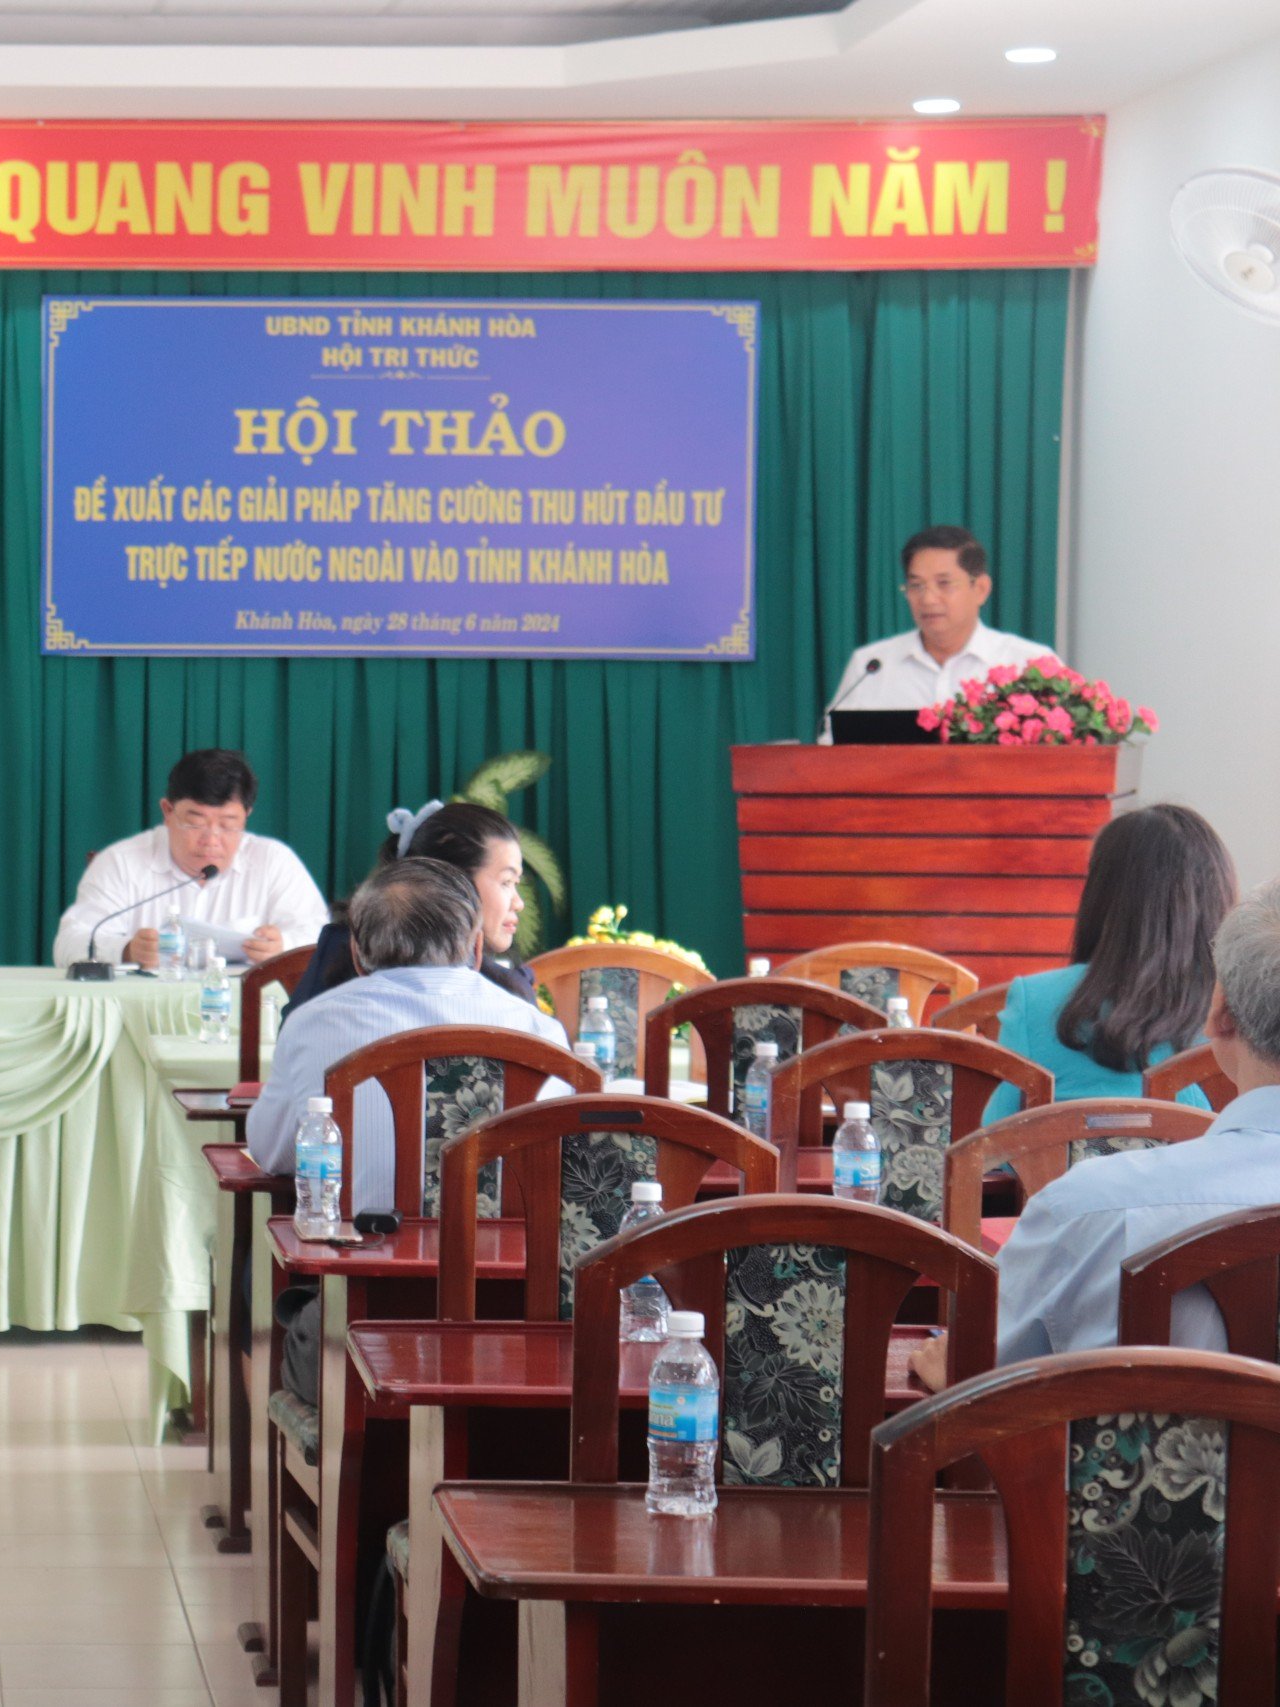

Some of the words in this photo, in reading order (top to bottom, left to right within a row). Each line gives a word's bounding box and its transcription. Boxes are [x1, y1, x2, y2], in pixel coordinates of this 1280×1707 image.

[297, 162, 496, 238] VINH
[524, 149, 782, 240] MUÔN
[809, 146, 1010, 238] NĂM
[1043, 160, 1067, 233] !
[265, 315, 332, 337] UBND
[337, 309, 394, 337] TỈNH
[400, 312, 482, 338] KHÁNH
[488, 313, 538, 338] HÒA
[322, 342, 363, 371] HỘI
[416, 343, 480, 369] THỨC
[234, 396, 359, 466] HỘI
[379, 393, 568, 458] THẢO
[113, 474, 177, 522] XUẤT
[182, 479, 233, 523] CÁC
[238, 475, 289, 523] GIẢI
[294, 480, 362, 523] PHÁP
[367, 481, 433, 524] TĂNG
[438, 480, 524, 525] CƯỜNG
[528, 488, 578, 526] THU
[582, 482, 630, 526] HÚT
[634, 478, 687, 527] ĐẦU
[691, 487, 726, 527] TƯ
[125, 542, 189, 589] TRỰC
[194, 534, 249, 582] TIẾP
[254, 539, 323, 583] NƯỚC
[328, 539, 406, 583] NGOÀI
[410, 539, 461, 584] VÀO
[465, 536, 523, 585] TỈNH
[527, 540, 613, 585] KHÁNH
[618, 540, 670, 586] HÒA
[235, 610, 294, 631] Khánh
[341, 612, 384, 635] ngày
[386, 612, 409, 631] 28
[411, 611, 462, 635] tháng
[465, 613, 477, 631] 6
[480, 612, 518, 632] năm
[521, 613, 561, 632] 2024
